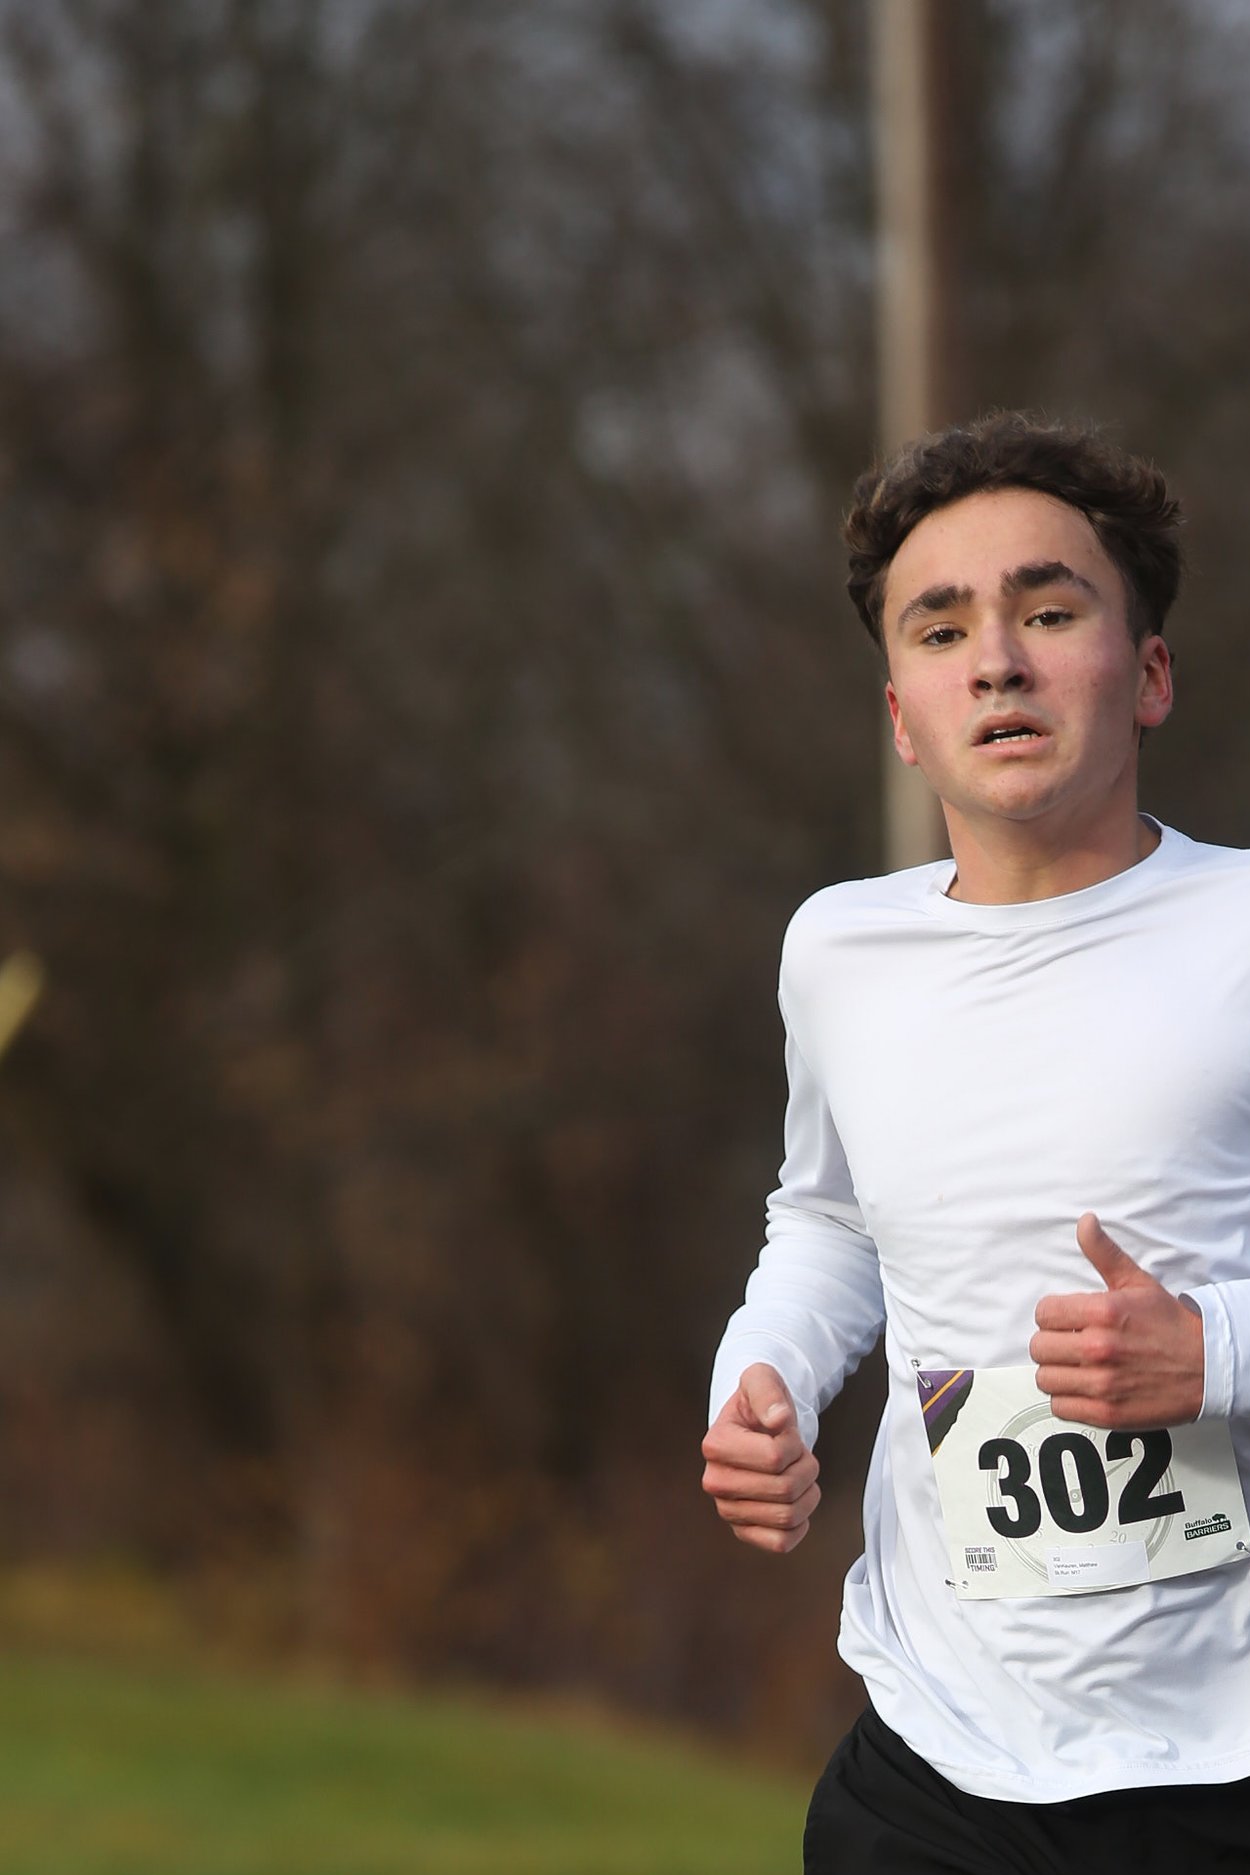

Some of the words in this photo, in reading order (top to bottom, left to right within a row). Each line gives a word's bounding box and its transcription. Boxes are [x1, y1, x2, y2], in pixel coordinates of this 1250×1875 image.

[978, 1428, 1186, 1539] 302
[1184, 1518, 1213, 1529] Buffalo
[1186, 1522, 1230, 1539] BARRIERS
[970, 1564, 996, 1572] TIMING
